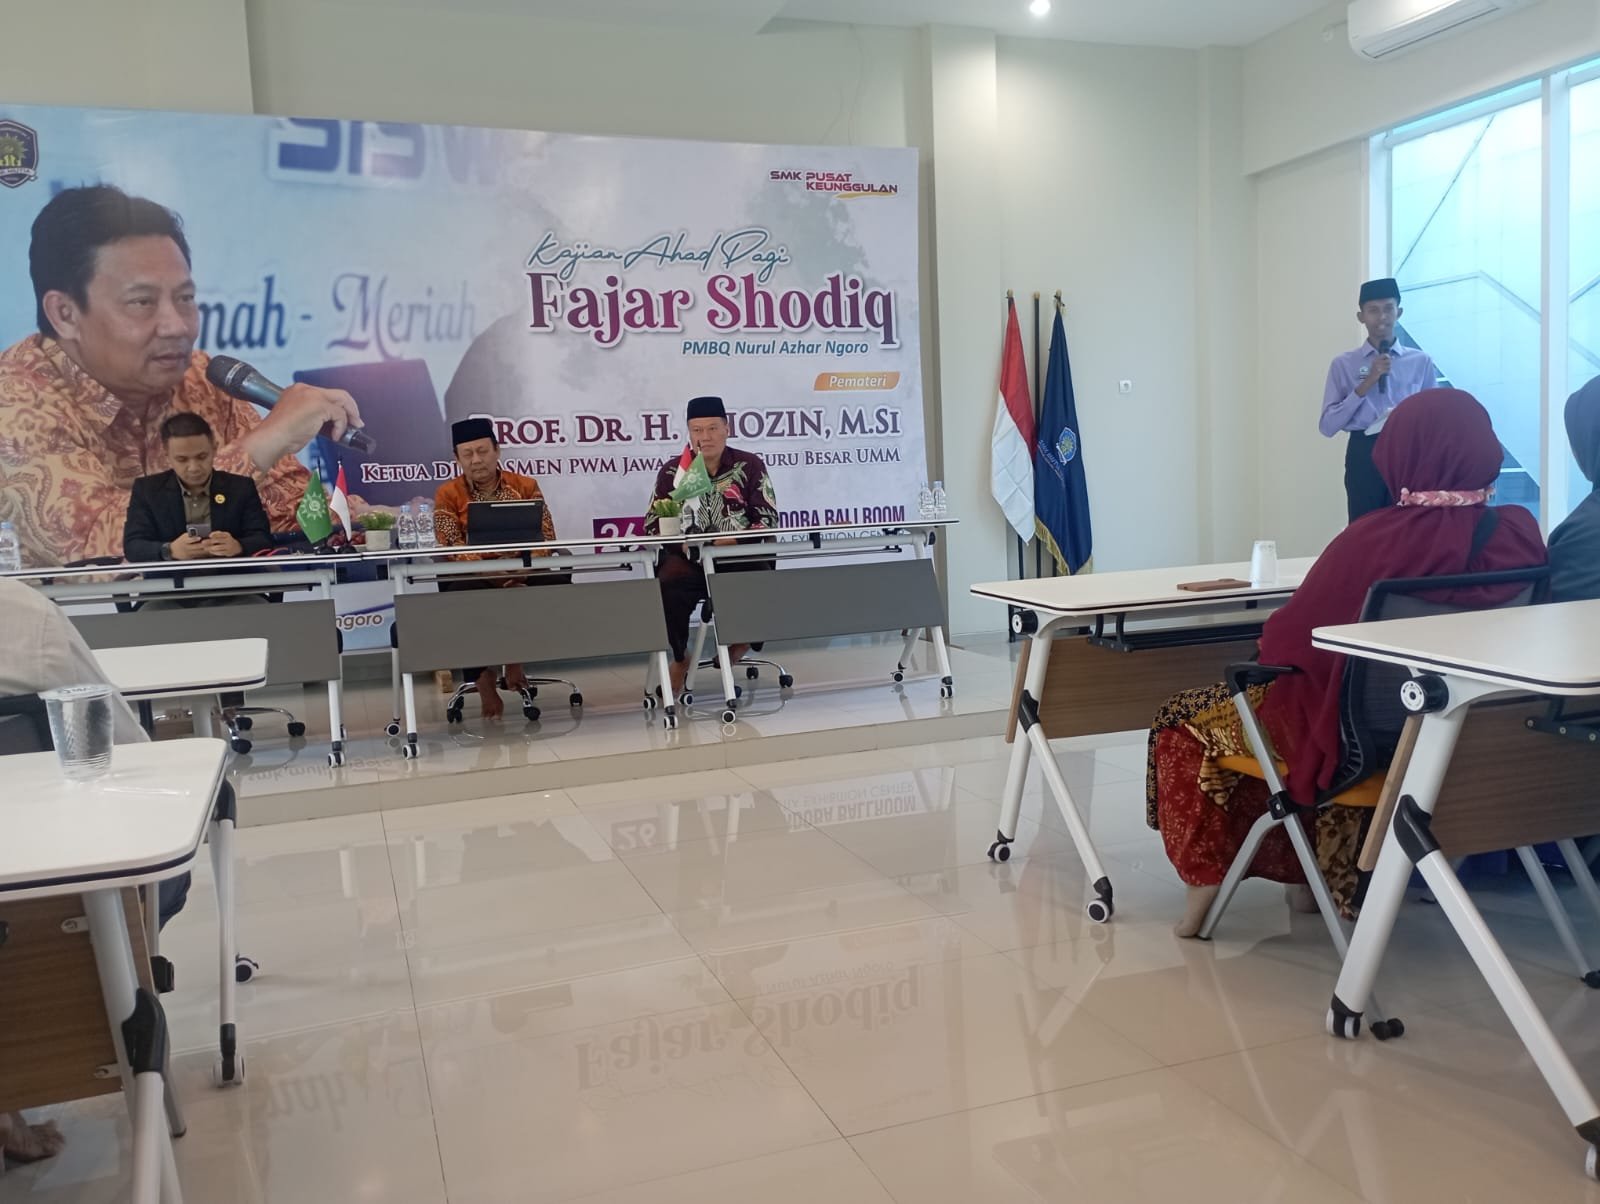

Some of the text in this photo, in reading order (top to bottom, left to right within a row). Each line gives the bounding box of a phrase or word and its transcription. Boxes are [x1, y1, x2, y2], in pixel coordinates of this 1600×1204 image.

[770, 170, 852, 182] SMK PUSAT
[806, 182, 898, 193] KEUNGGULAN
[528, 232, 622, 280] Kajian
[624, 233, 721, 270] Ahad
[526, 272, 896, 345] Fajar Shodiq
[682, 340, 869, 356] PMBQ Nurul Azhar Ngoro
[829, 374, 887, 388] Pemateri
[494, 419, 566, 445] ROF.
[576, 416, 632, 442] DR.
[642, 414, 679, 441] H.
[363, 463, 432, 482] KETUA
[570, 457, 617, 474] PWM
[805, 450, 850, 465] BESAR
[856, 447, 900, 464] UMM
